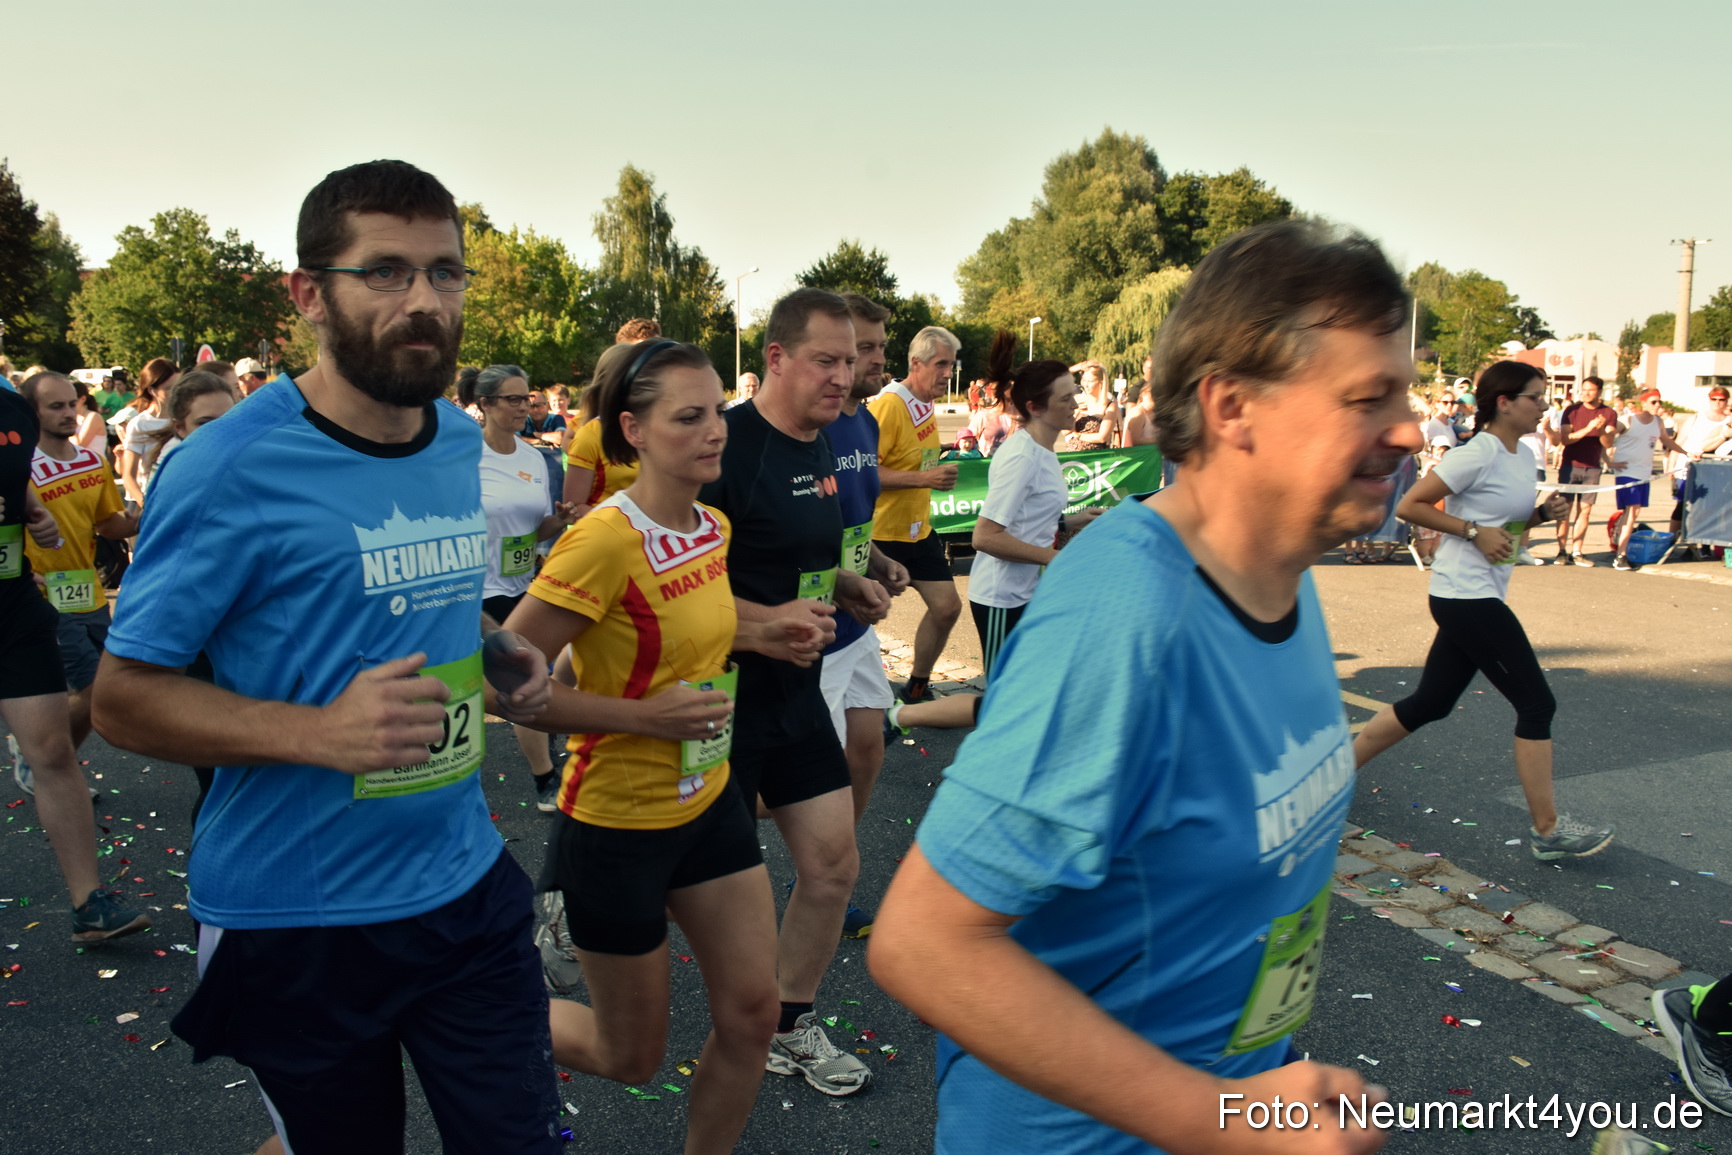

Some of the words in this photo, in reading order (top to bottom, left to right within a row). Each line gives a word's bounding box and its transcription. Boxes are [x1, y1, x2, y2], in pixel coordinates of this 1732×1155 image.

[41, 482, 76, 502] MAX
[55, 584, 89, 601] 1241
[659, 568, 705, 602] MAX
